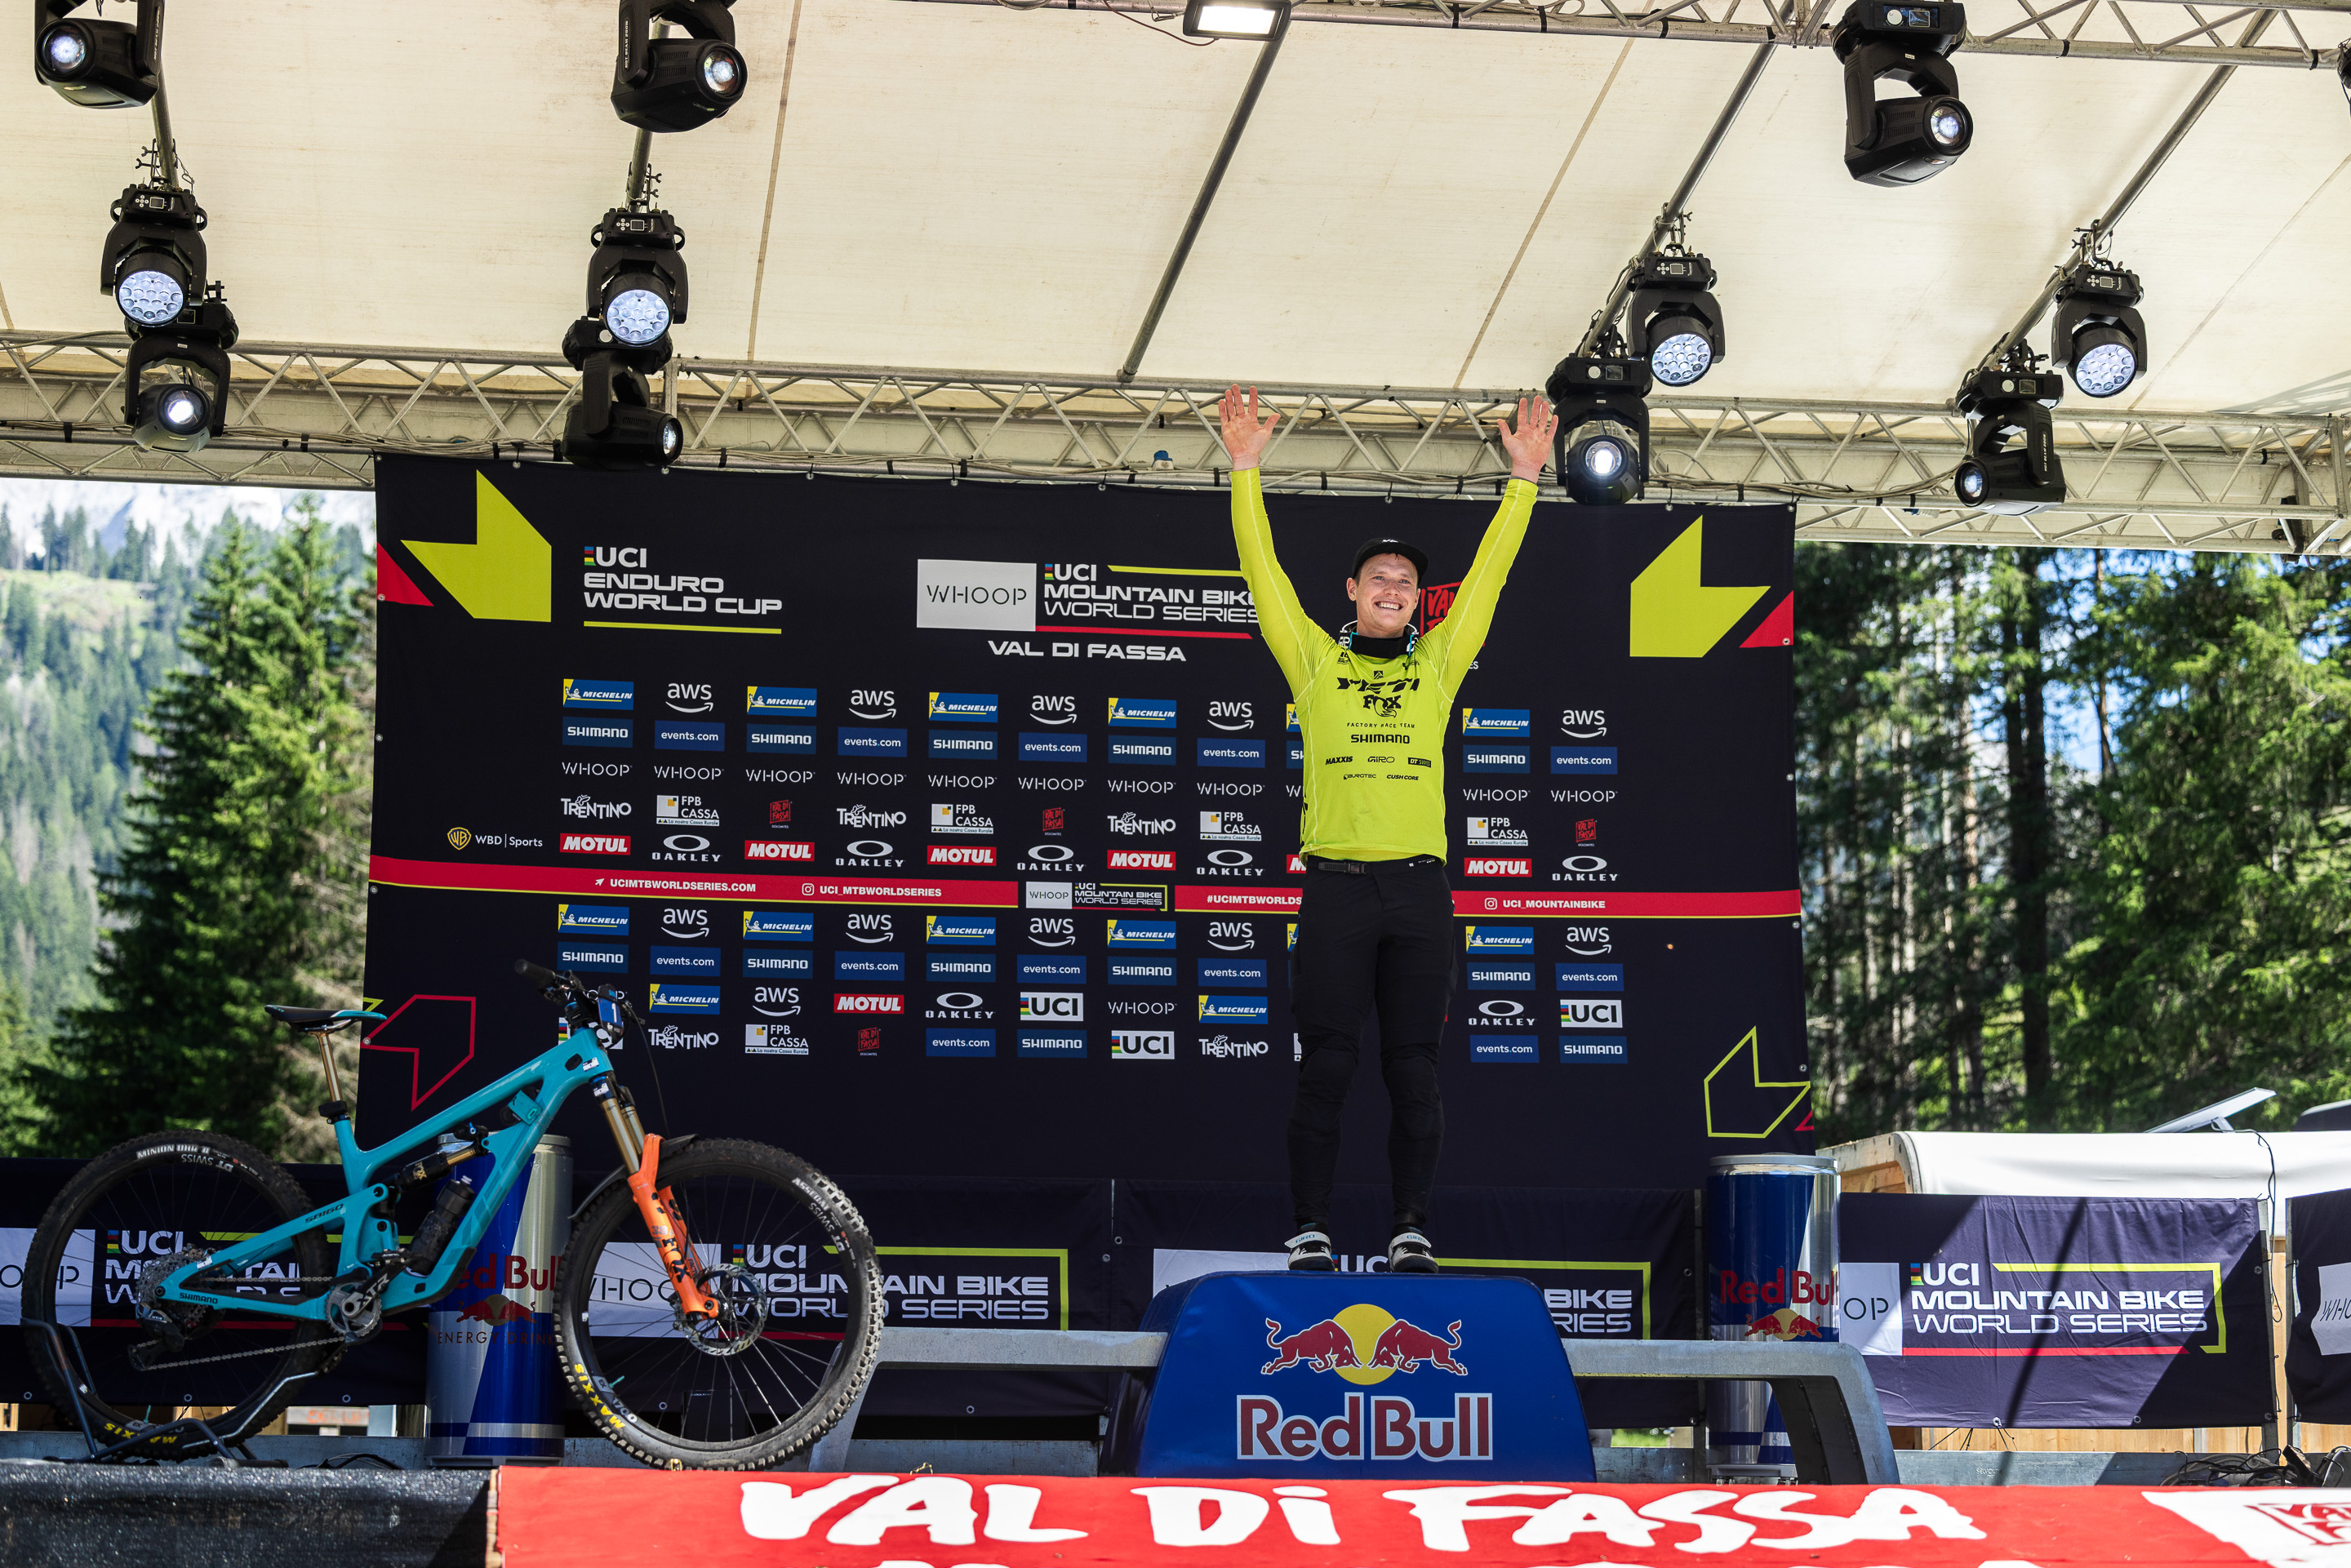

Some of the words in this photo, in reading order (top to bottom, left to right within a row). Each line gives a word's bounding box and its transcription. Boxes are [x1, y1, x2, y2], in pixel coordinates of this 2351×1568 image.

[597, 547, 647, 567] UCI
[1055, 564, 1096, 581] UCI
[584, 573, 723, 595] ENDURO
[927, 584, 1027, 605] WHOOP
[1045, 584, 1193, 606] MOUNTAIN
[584, 592, 706, 611] WORLD
[716, 597, 782, 614] CUP
[1045, 602, 1154, 619] WORLD
[988, 641, 1043, 656] VAL
[1052, 642, 1078, 657] DI
[1087, 644, 1186, 661] FASSA
[767, 698, 816, 706] MICHELIN
[948, 704, 997, 712] MICHELIN
[1032, 695, 1075, 711] aws
[1210, 701, 1251, 717] aws
[1362, 695, 1402, 717] FOX
[1127, 709, 1176, 717] MICHELIN
[1562, 710, 1605, 725] aws
[752, 734, 811, 744] SHIMANO
[934, 740, 993, 749] SHIMANO
[1351, 735, 1410, 744] SHIMANO
[1204, 749, 1259, 757] events.com
[1325, 756, 1353, 765] MAXXIS
[837, 772, 904, 785] WHOOP
[1018, 778, 1084, 791] WHOOP
[1108, 780, 1174, 793] WHOOP
[1197, 783, 1263, 796] WHOOP
[682, 796, 701, 806] FPB
[1464, 788, 1528, 802] WHOOP
[561, 798, 632, 819] TRENTINO
[681, 807, 719, 819] CASSA
[956, 805, 976, 814] FPB
[837, 808, 907, 828] TRENTINO
[955, 816, 993, 827] CASSA
[1224, 812, 1243, 821] FPB
[1491, 818, 1510, 827] FPB
[1107, 815, 1176, 835] TRENTINO
[1224, 824, 1261, 834] CASSA
[1491, 828, 1527, 839] CASSA
[476, 835, 502, 845] WBD
[509, 837, 542, 847] Sports
[562, 837, 628, 852] MOTUL
[748, 843, 811, 859] MOTUL
[931, 848, 993, 864] MOTUL
[836, 858, 904, 867] OAKLEY
[1016, 862, 1084, 872] OAKLEY
[1110, 853, 1173, 868] MOTUL
[1467, 860, 1529, 874] MOTUL
[1197, 867, 1264, 876] OAKLEY
[1552, 873, 1618, 882] OAKLEY
[610, 878, 756, 892] UCIMTBWORLDSERIES.COM
[820, 886, 942, 897] UCI_MTBWORLDSERIES
[1029, 891, 1069, 899] WHOOP
[1075, 891, 1136, 901] MOUNTAIN
[1136, 892, 1162, 901] BIKE
[1503, 899, 1606, 908] UCI_MOUNTAINBIKE
[577, 917, 628, 925] MICHELIN
[664, 908, 707, 925] aws
[848, 914, 891, 930] aws
[1567, 927, 1609, 942] aws
[562, 952, 623, 963] SHIMANO
[657, 957, 713, 966] events.com
[748, 959, 807, 969] SHIMANO
[931, 963, 991, 972] SHIMANO
[1113, 966, 1171, 975] SHIMANO
[669, 996, 719, 1004] MICHELIN
[837, 997, 901, 1011] MOTUL
[1032, 997, 1078, 1016] UCI
[611, 1002, 617, 1023] 1
[926, 1011, 993, 1019] OAKLEY
[1571, 1005, 1616, 1023] UCI
[771, 1025, 790, 1034] FPB
[648, 1028, 718, 1049] TRENTINO
[771, 1037, 808, 1047] CASSA
[1124, 1036, 1170, 1054] UCI
[1199, 1038, 1268, 1058] TRENTINO
[747, 1245, 807, 1268] UCI
[456, 1253, 496, 1290] ed
[1922, 1263, 1980, 1286] UCI
[957, 1276, 1049, 1296] BIKE
[1721, 1268, 1785, 1304] Red
[180, 1292, 218, 1304] SHIMANO
[1544, 1289, 1632, 1308] BIKE
[1911, 1290, 2108, 1310] MOUNTAIN
[2120, 1290, 2203, 1309] BIKE
[901, 1299, 1049, 1320] SERIES
[1551, 1313, 1631, 1333] RIES
[1913, 1314, 2059, 1334] WORLD
[2070, 1313, 2207, 1334] SERIES
[438, 1331, 500, 1344] ENERGY
[575, 1363, 625, 1428] MAXXIS
[1237, 1392, 1364, 1460] Red
[1371, 1392, 1493, 1462] Bull
[741, 1474, 1088, 1546] VAL
[1382, 1484, 1988, 1554] FASSA
